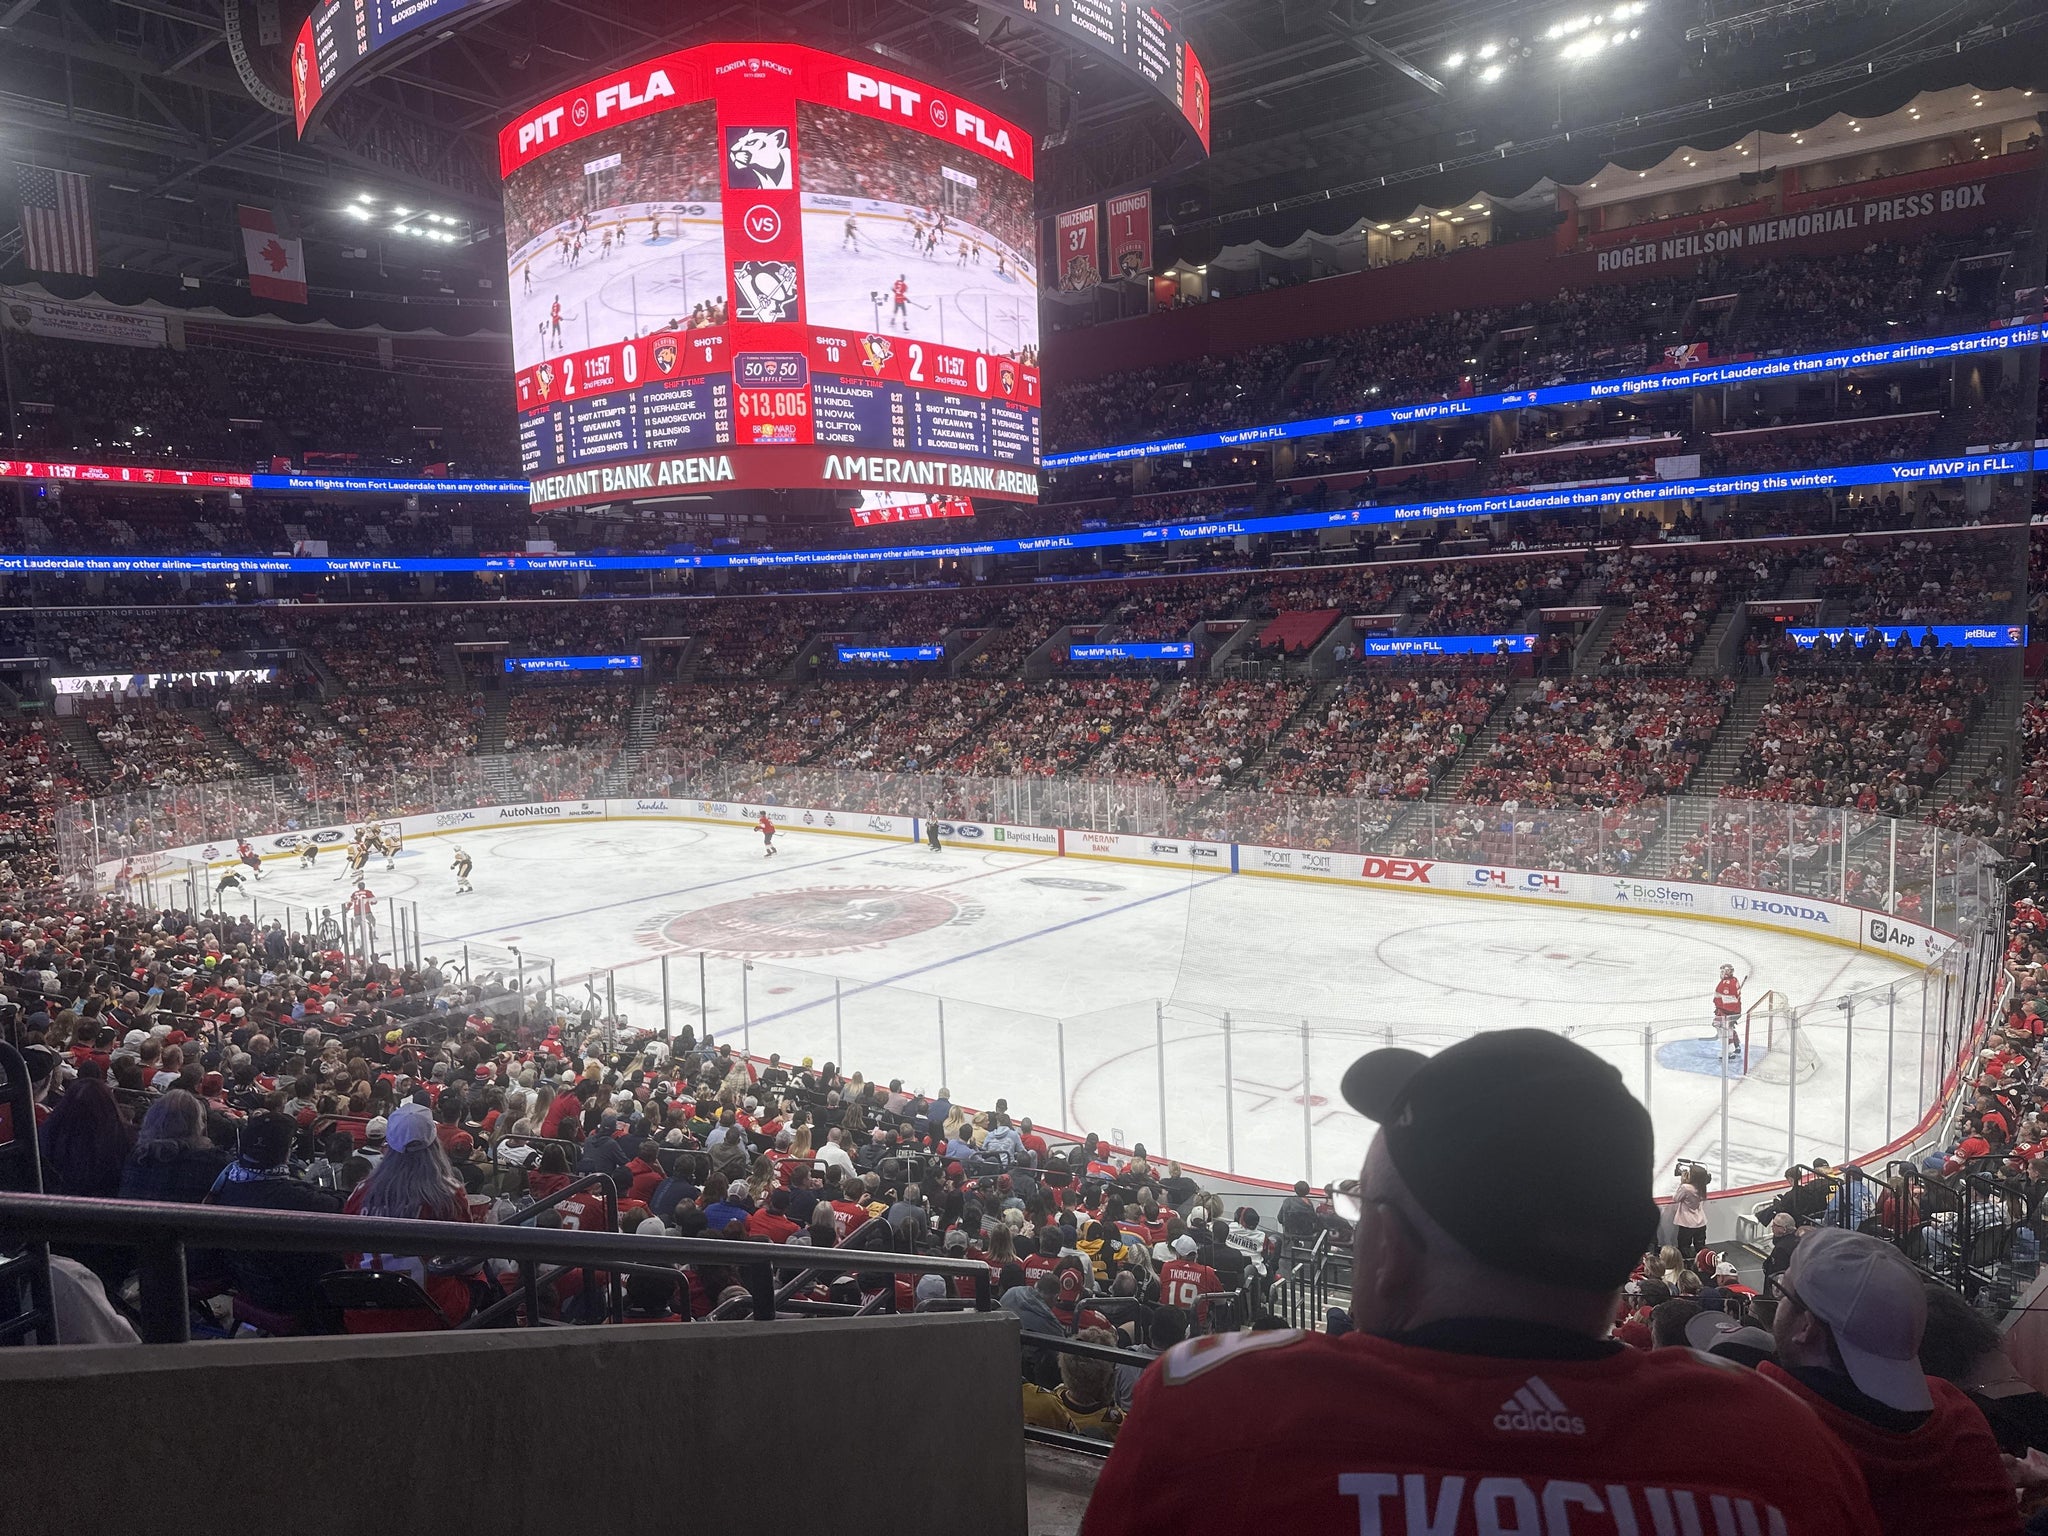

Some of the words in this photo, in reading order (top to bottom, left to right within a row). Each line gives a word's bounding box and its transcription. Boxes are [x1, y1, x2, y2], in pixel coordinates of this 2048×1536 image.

[715, 59, 746, 75] FLORIDA
[761, 59, 793, 75] HOCKEY
[518, 107, 564, 153] PIT
[575, 107, 585, 119] VS
[596, 70, 675, 119] FLA
[847, 71, 921, 117] PIT
[934, 108, 944, 120] VS
[955, 108, 1015, 159] FLA
[1111, 196, 1147, 216] LUONGO
[752, 217, 774, 232] VS
[1060, 208, 1094, 229] HUIZENGA
[1125, 215, 1134, 236] 1
[1598, 243, 1657, 272] ROGER
[1661, 228, 1743, 260] NEILSON
[1747, 209, 1858, 247] MEMORIAL
[1864, 194, 1935, 224] PRESS
[1941, 184, 1987, 211] BOX
[1069, 228, 1087, 251] 37
[694, 337, 722, 347] SHOTS
[816, 336, 847, 347] SHOTS
[826, 347, 840, 363] 10
[909, 344, 924, 382] 2
[937, 355, 965, 377] 11:57
[975, 356, 988, 393] 0
[1591, 384, 1620, 395] More
[1622, 379, 1659, 393] flights
[1662, 377, 1690, 387] from
[1692, 372, 1718, 384] Fort
[1721, 363, 1790, 379] Lauderdale
[1793, 358, 1822, 371] than
[1828, 356, 1849, 367] any
[1852, 351, 1889, 363] other
[2011, 330, 2039, 343] this
[563, 359, 575, 395] 2
[584, 355, 610, 378] 11:57
[622, 345, 637, 383] 0
[745, 363, 763, 376] 50
[780, 363, 797, 376] 50
[583, 381, 595, 390] 2nd
[594, 377, 614, 387] PERIOD
[840, 377, 864, 386] SHIFT
[866, 379, 884, 388] TIME
[935, 375, 948, 385] 2nd
[948, 377, 968, 388] PERIOD
[650, 390, 693, 402] RODRIGUES
[823, 386, 873, 398] HALLANDER
[592, 399, 607, 408] HITS
[739, 392, 807, 419] $13,605
[824, 398, 854, 408] KINDEL
[944, 396, 961, 405] HITS
[1502, 394, 1522, 404] jetBlue
[651, 401, 696, 414] VERHAEGHE
[926, 405, 944, 414] SHOT
[945, 408, 978, 419] ATTEMPTS
[1391, 411, 1413, 421] Your
[1415, 407, 1438, 418] MVP
[1439, 404, 1449, 415] in
[1450, 402, 1471, 413] FLL.
[577, 412, 593, 422] SHOT
[593, 407, 626, 419] ATTEMPTS
[652, 412, 706, 425] SAMOSKEVICH
[824, 410, 855, 419] NOVAK
[583, 420, 621, 432] GIVEAWAYS
[825, 422, 861, 432] CLIFTON
[932, 417, 973, 429] GIVEAWAYS
[583, 431, 623, 444] TAKEAWAYS
[652, 426, 690, 437] BALINSKIS
[826, 433, 855, 443] JONES
[932, 428, 975, 440] TAKEAWAYS
[580, 445, 606, 456] BLOCKED
[607, 442, 628, 452] SHOTS
[653, 439, 678, 449] PETRY
[927, 439, 958, 449] BLOCKED
[959, 442, 979, 452] SHOTS
[25, 464, 33, 476] 2
[48, 465, 76, 478] 11:57
[122, 469, 130, 480] 0
[1892, 466, 1926, 478] Your
[1929, 463, 1964, 475] MVP
[1967, 461, 1980, 472] in
[1984, 458, 2014, 471] FLL.
[529, 470, 600, 505] AMERANT
[602, 463, 653, 492] BANK
[657, 455, 736, 486] ARENA
[823, 455, 947, 485] AMERANT
[951, 465, 996, 490] BANK
[995, 470, 1039, 496] ARENA
[1395, 508, 1420, 518] More
[1423, 503, 1455, 518] flights
[1457, 502, 1482, 512] from
[1484, 499, 1507, 510] Fort
[1509, 495, 1569, 509] Lauderdale
[1572, 493, 1598, 504] than
[1600, 490, 1621, 502] any
[1624, 487, 1657, 499] other
[1763, 477, 1788, 488] this
[1790, 473, 1837, 486] winter.
[24, 559, 85, 568] Lauderdale
[87, 560, 110, 569] than
[112, 561, 131, 571] any
[133, 560, 160, 569] other
[240, 561, 258, 570] this
[259, 561, 292, 570] winter.
[1965, 629, 1997, 640] jetBlue
[1370, 643, 1389, 651] Your
[1391, 642, 1412, 651] MVP
[1413, 642, 1422, 650] in
[1424, 641, 1442, 650] FLL.
[499, 805, 561, 818] AutoNation
[636, 801, 668, 811] Sandals
[317, 831, 339, 842] Ford
[961, 827, 979, 838] Ford
[1006, 830, 1030, 843] Baptist
[1032, 832, 1056, 844] Health
[1083, 834, 1119, 844] AMERANT
[1092, 844, 1110, 852] BANK
[1271, 851, 1290, 863] JOINT
[1310, 855, 1330, 867] JOINT
[1361, 858, 1434, 883] DEX
[1475, 869, 1505, 884] CH
[1527, 873, 1560, 888] CH
[1633, 884, 1694, 902] BioStem
[1751, 899, 1831, 924] HONDA
[1888, 928, 1916, 948] App
[1227, 1234, 1258, 1250] PANTHERS
[1170, 1268, 1202, 1283] TKACHUK
[1168, 1281, 1199, 1305] 19
[1493, 1411, 1586, 1434] adidas
